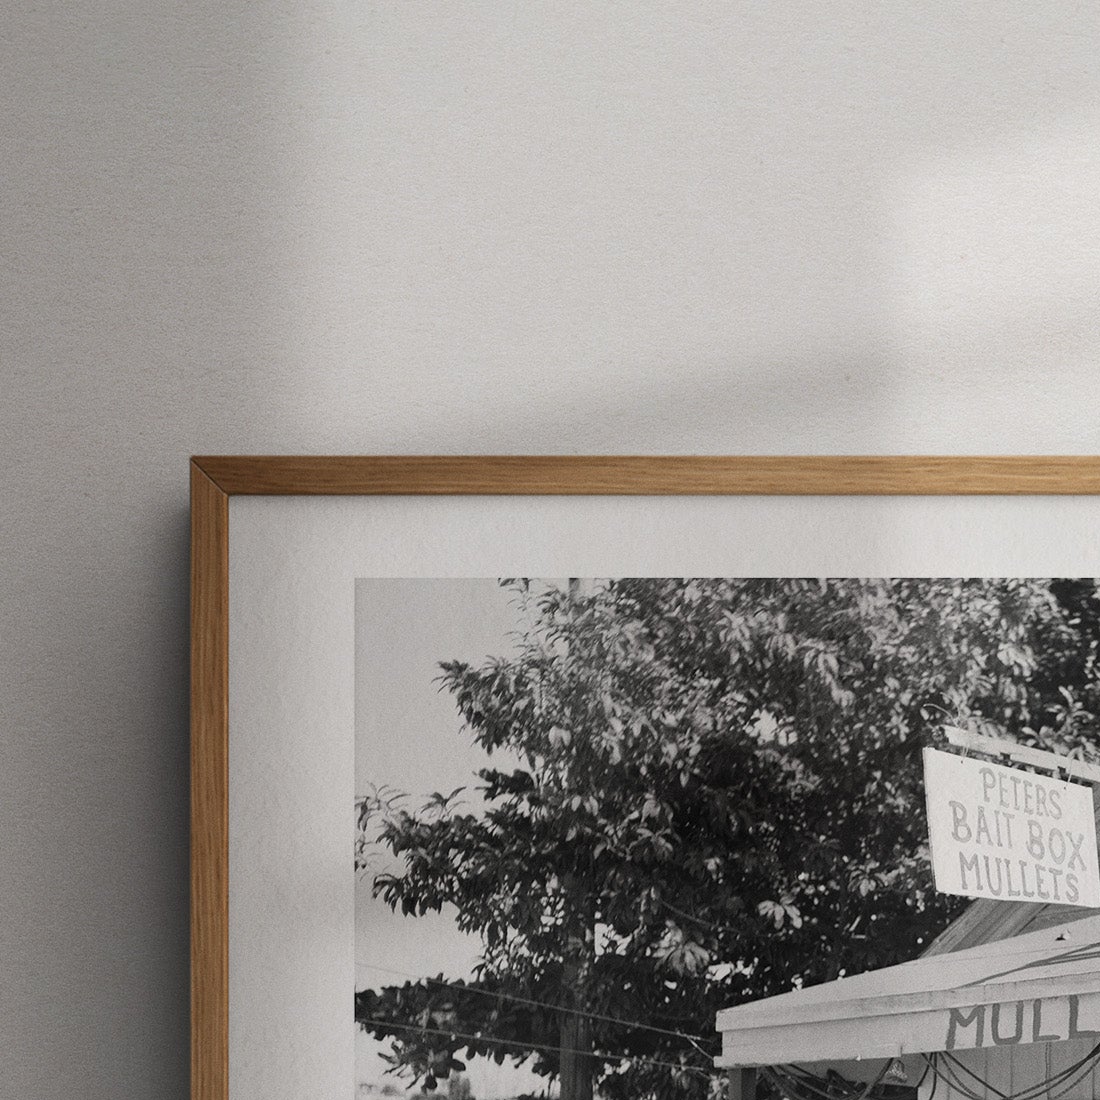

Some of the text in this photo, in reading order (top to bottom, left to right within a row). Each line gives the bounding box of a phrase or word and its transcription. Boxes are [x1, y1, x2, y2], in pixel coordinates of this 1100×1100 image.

[979, 766, 1062, 820] PETERS
[948, 800, 1087, 871] BAIT BOX
[959, 851, 1080, 903] MULLETS
